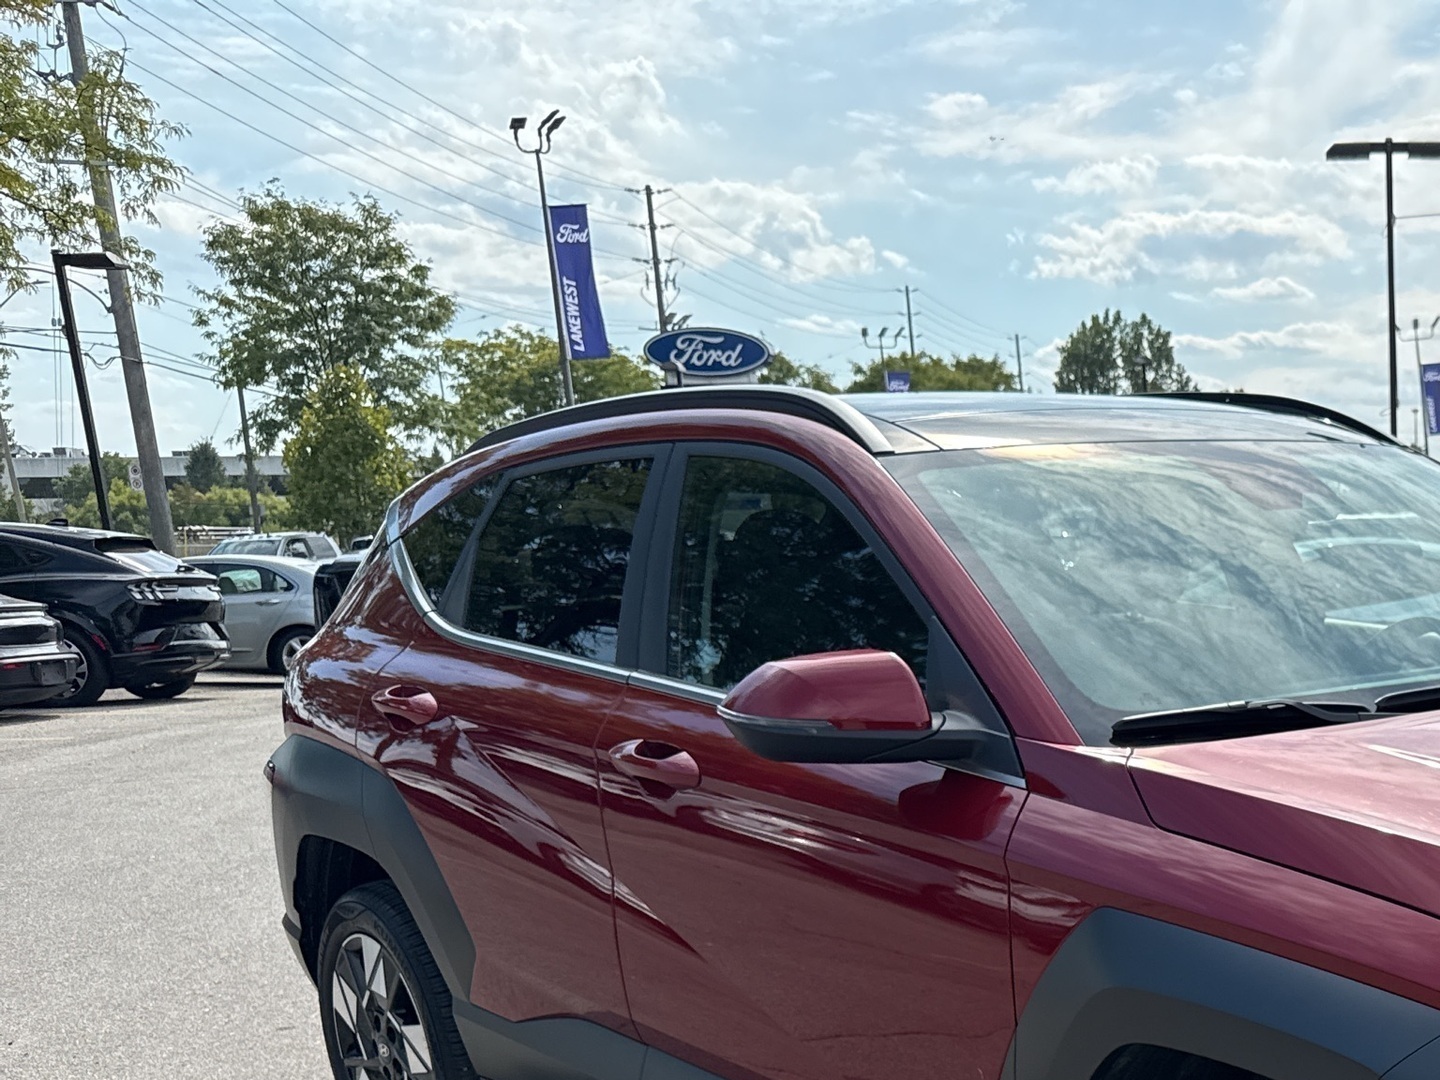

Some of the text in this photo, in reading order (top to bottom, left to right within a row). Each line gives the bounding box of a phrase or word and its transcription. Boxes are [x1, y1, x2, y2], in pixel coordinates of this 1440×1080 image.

[556, 223, 589, 245] Ford
[562, 275, 586, 353] LAKEWEST
[671, 335, 744, 371] Ford
